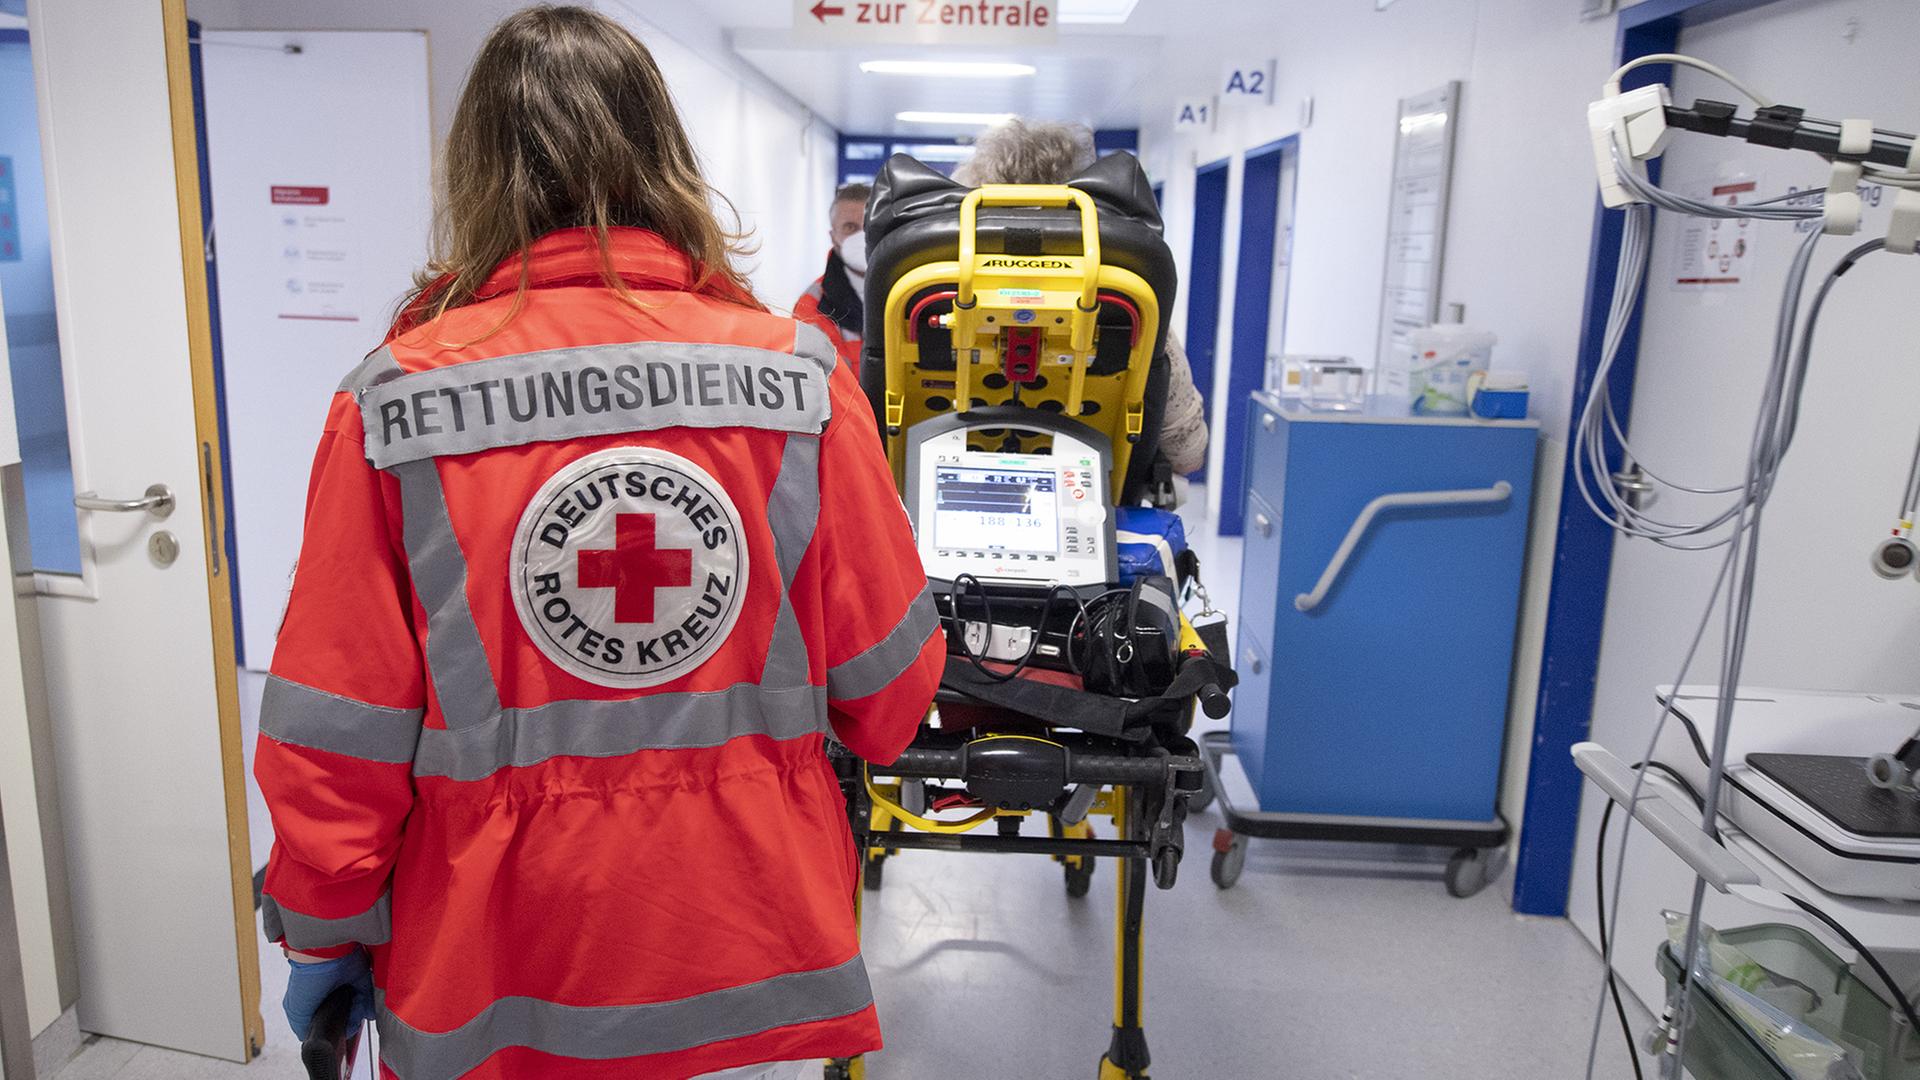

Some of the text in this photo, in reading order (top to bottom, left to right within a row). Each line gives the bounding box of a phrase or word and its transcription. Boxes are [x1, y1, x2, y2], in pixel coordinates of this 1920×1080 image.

[856, 0, 1049, 27] zur Zentrale
[1226, 70, 1265, 94] A2
[1179, 104, 1207, 123] A1
[991, 259, 1062, 269] RUGGED
[379, 361, 808, 447] RETTUNGSDIENST
[539, 471, 728, 550] DEUTSCHES
[980, 515, 1042, 528] 188 136
[534, 572, 731, 665] ROTES KREUZ
